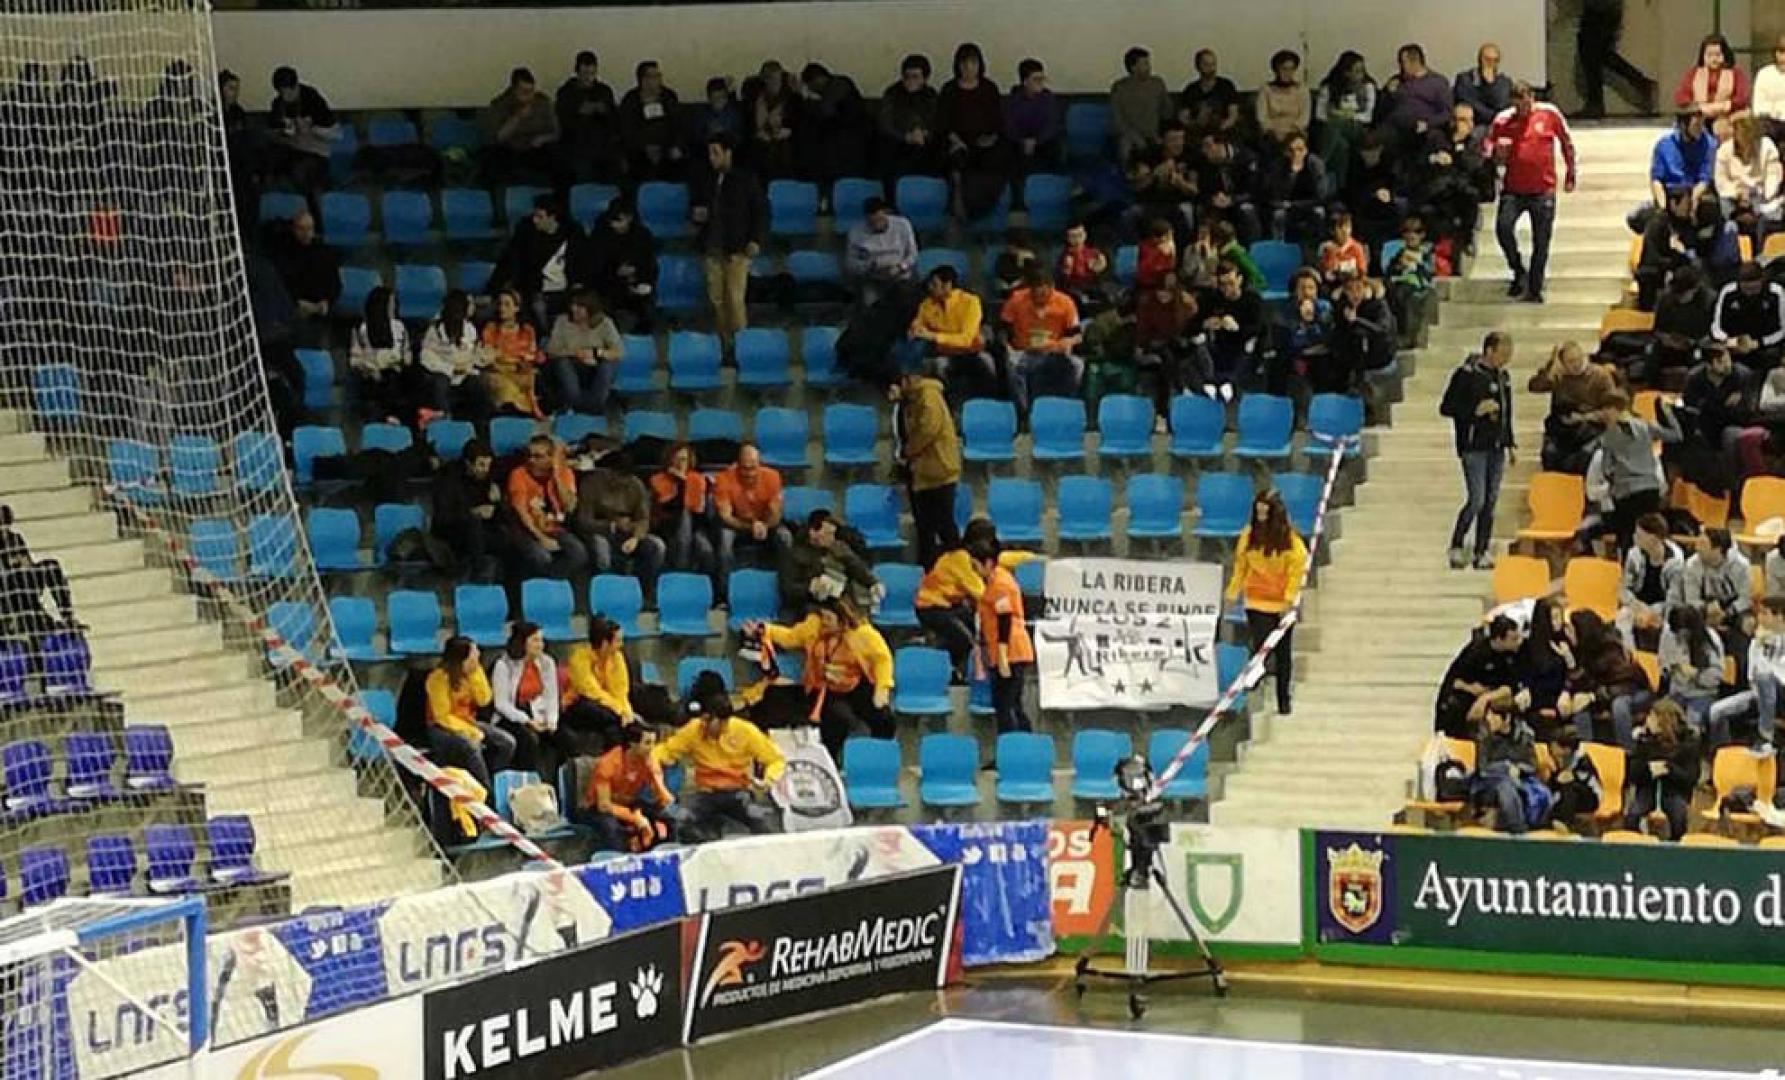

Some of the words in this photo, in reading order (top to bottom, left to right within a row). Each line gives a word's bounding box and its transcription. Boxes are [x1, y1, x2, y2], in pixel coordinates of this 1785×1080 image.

[1081, 569, 1105, 590] LA
[1113, 572, 1186, 595] RIBERA
[1045, 596, 1117, 615] NUNCA
[1414, 860, 1742, 926] Ayuntamiento
[1754, 873, 1785, 926] d
[443, 980, 618, 1080] KELME
